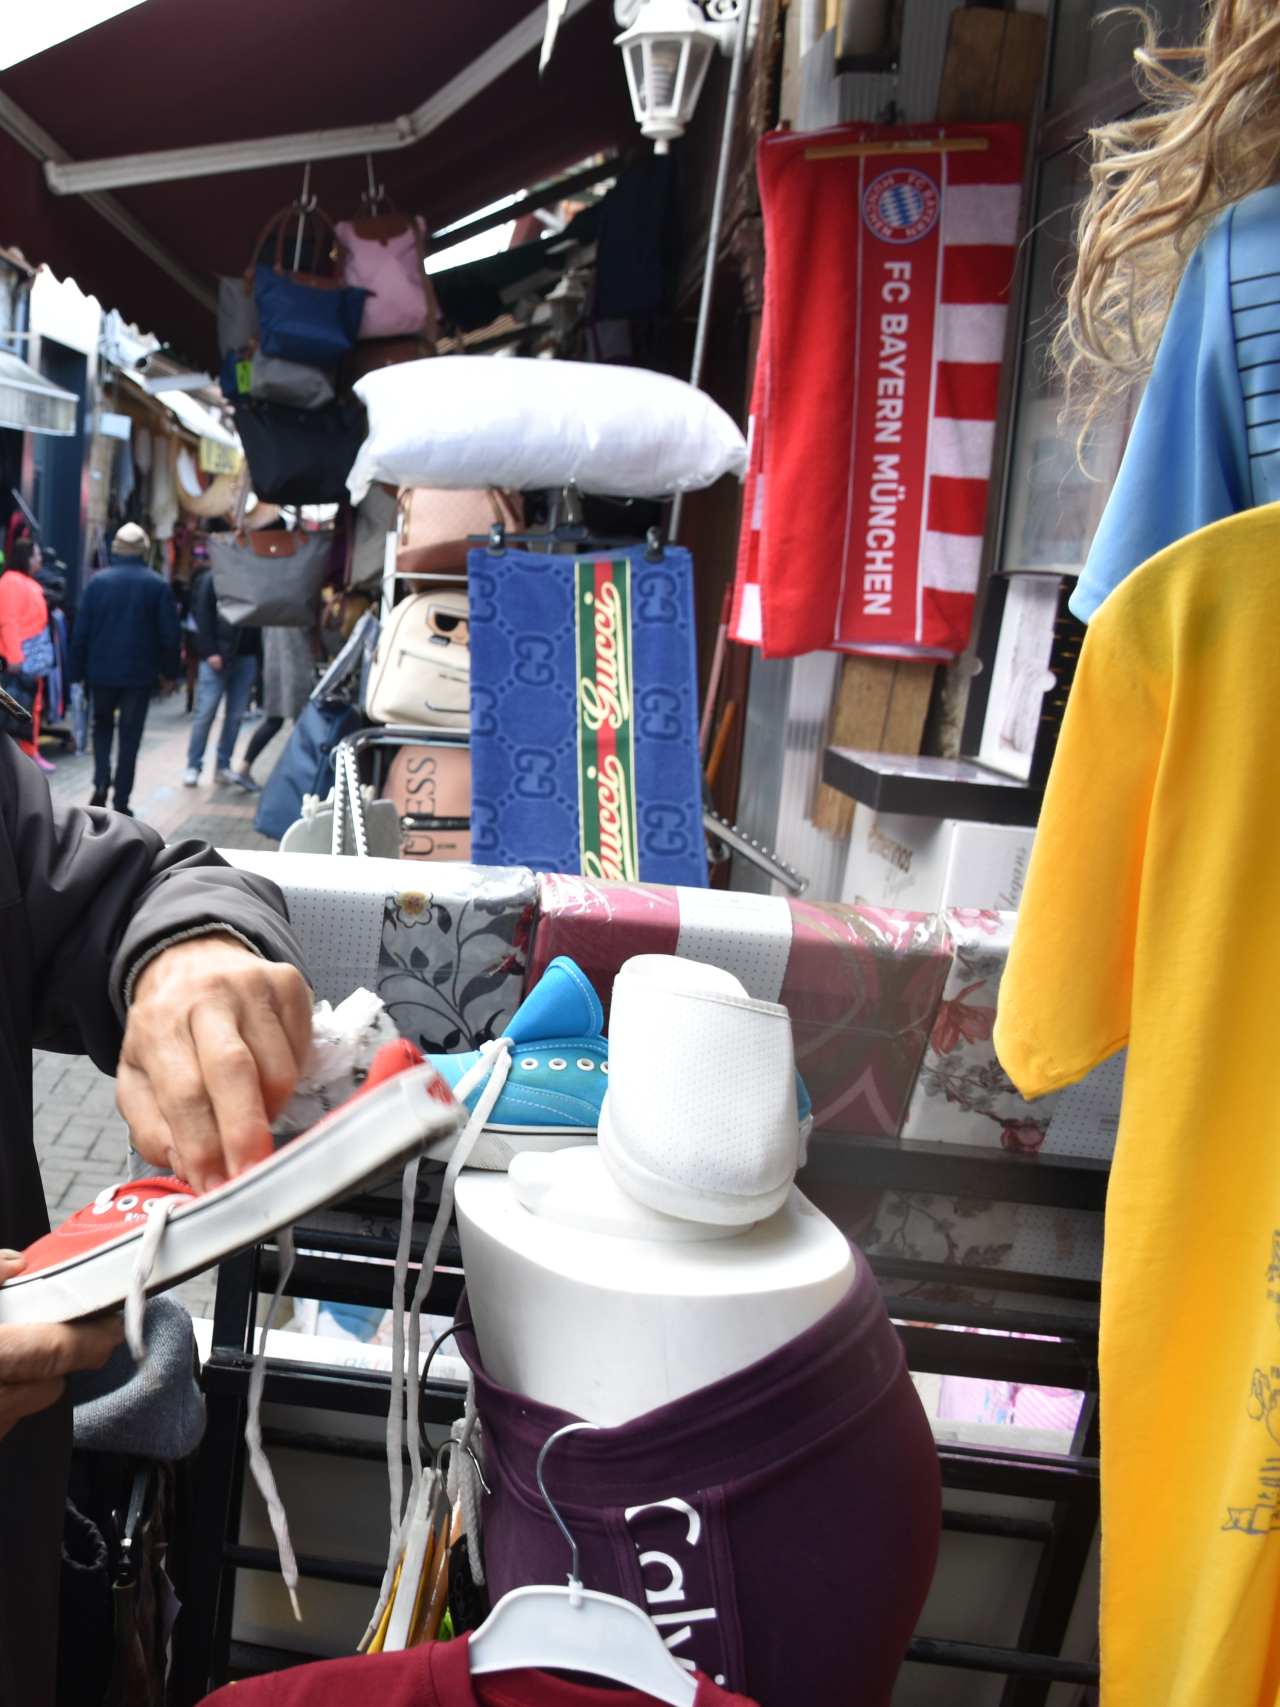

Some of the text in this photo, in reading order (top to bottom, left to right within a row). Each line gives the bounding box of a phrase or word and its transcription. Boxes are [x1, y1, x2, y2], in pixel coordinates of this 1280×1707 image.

[862, 260, 913, 616] FC BAYERN MÜNCHEN
[579, 580, 632, 730] Gucci
